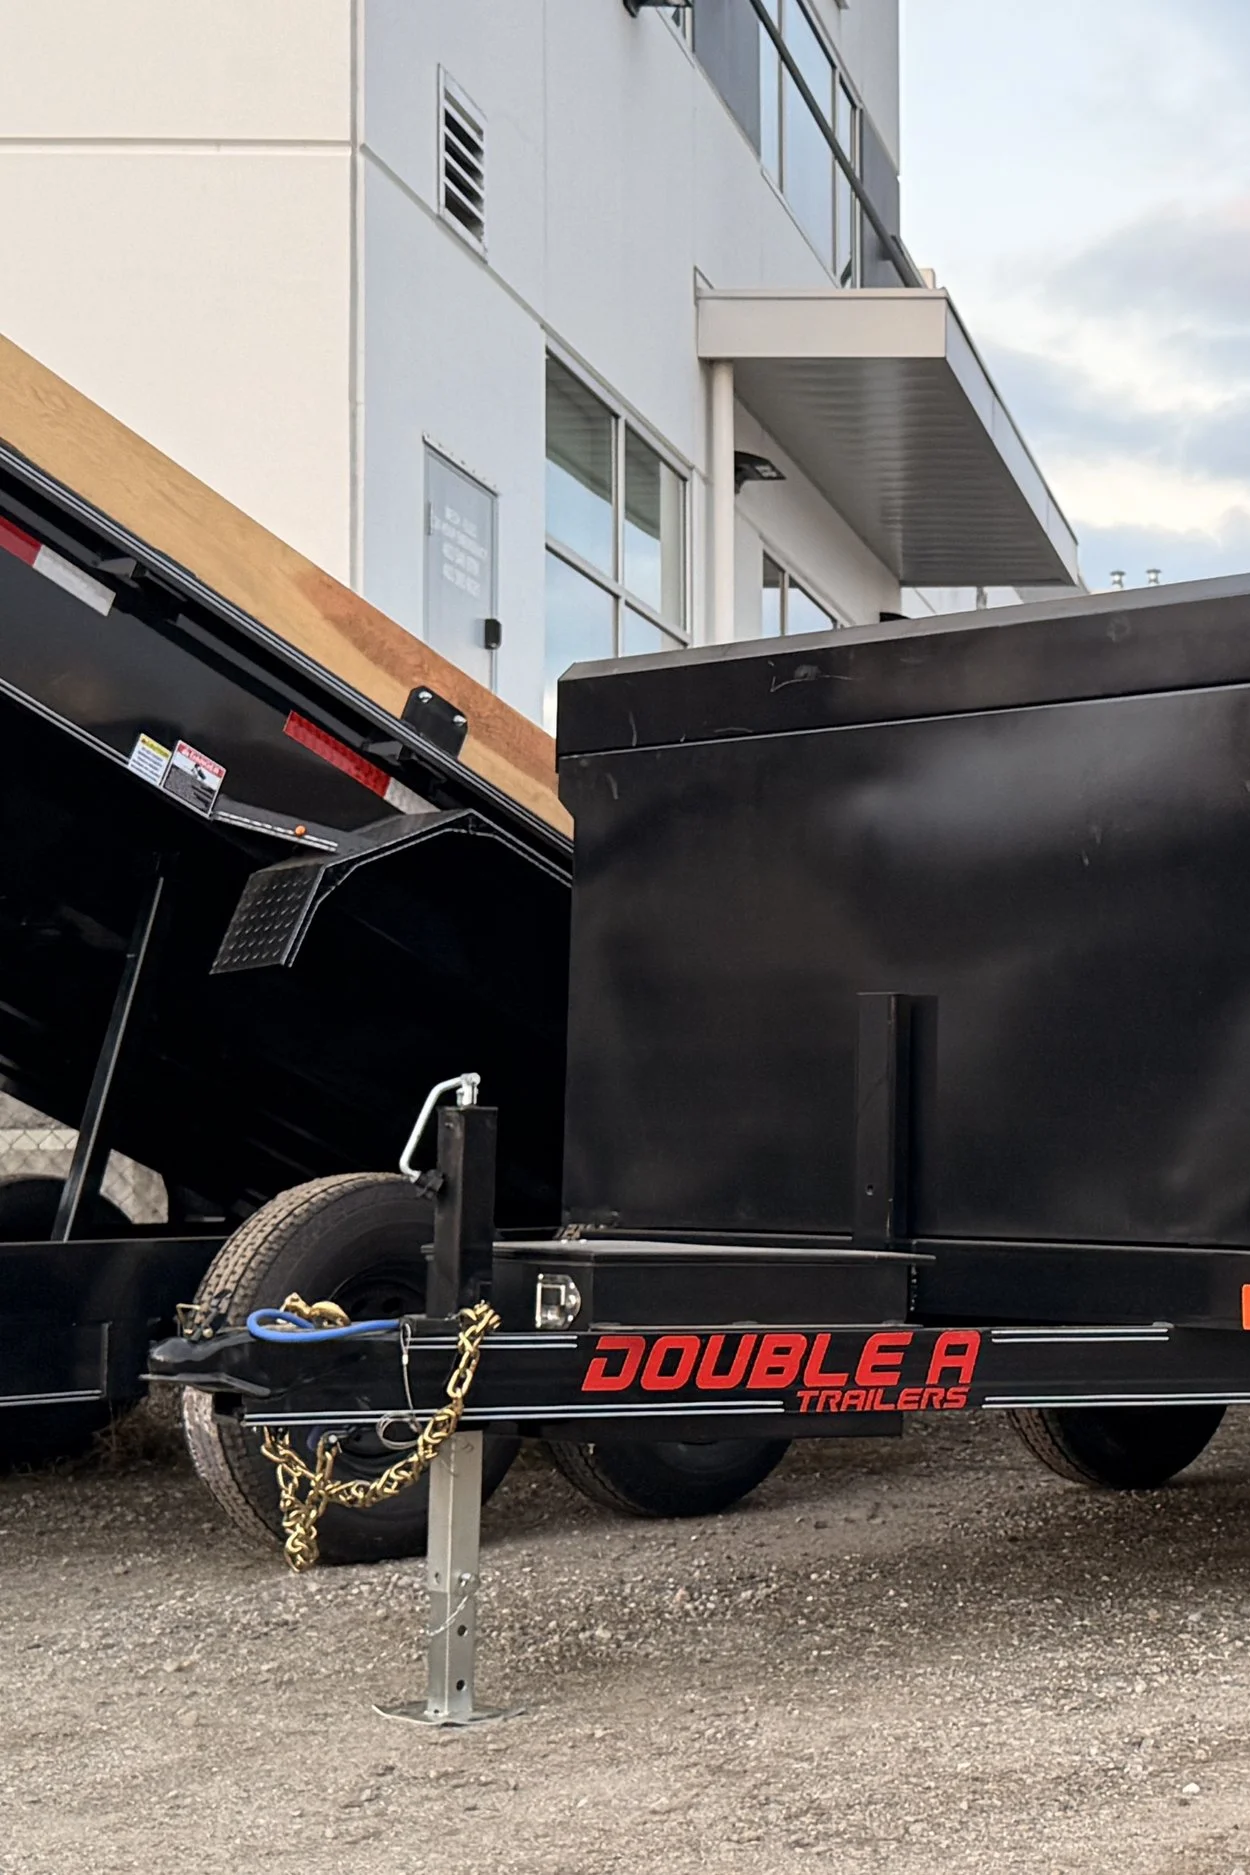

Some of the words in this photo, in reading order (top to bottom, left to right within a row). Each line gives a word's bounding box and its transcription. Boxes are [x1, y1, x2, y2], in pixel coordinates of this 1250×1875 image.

[582, 1331, 913, 1392] DOUBLE
[925, 1330, 981, 1385] A
[797, 1386, 971, 1413] TRAILERS
